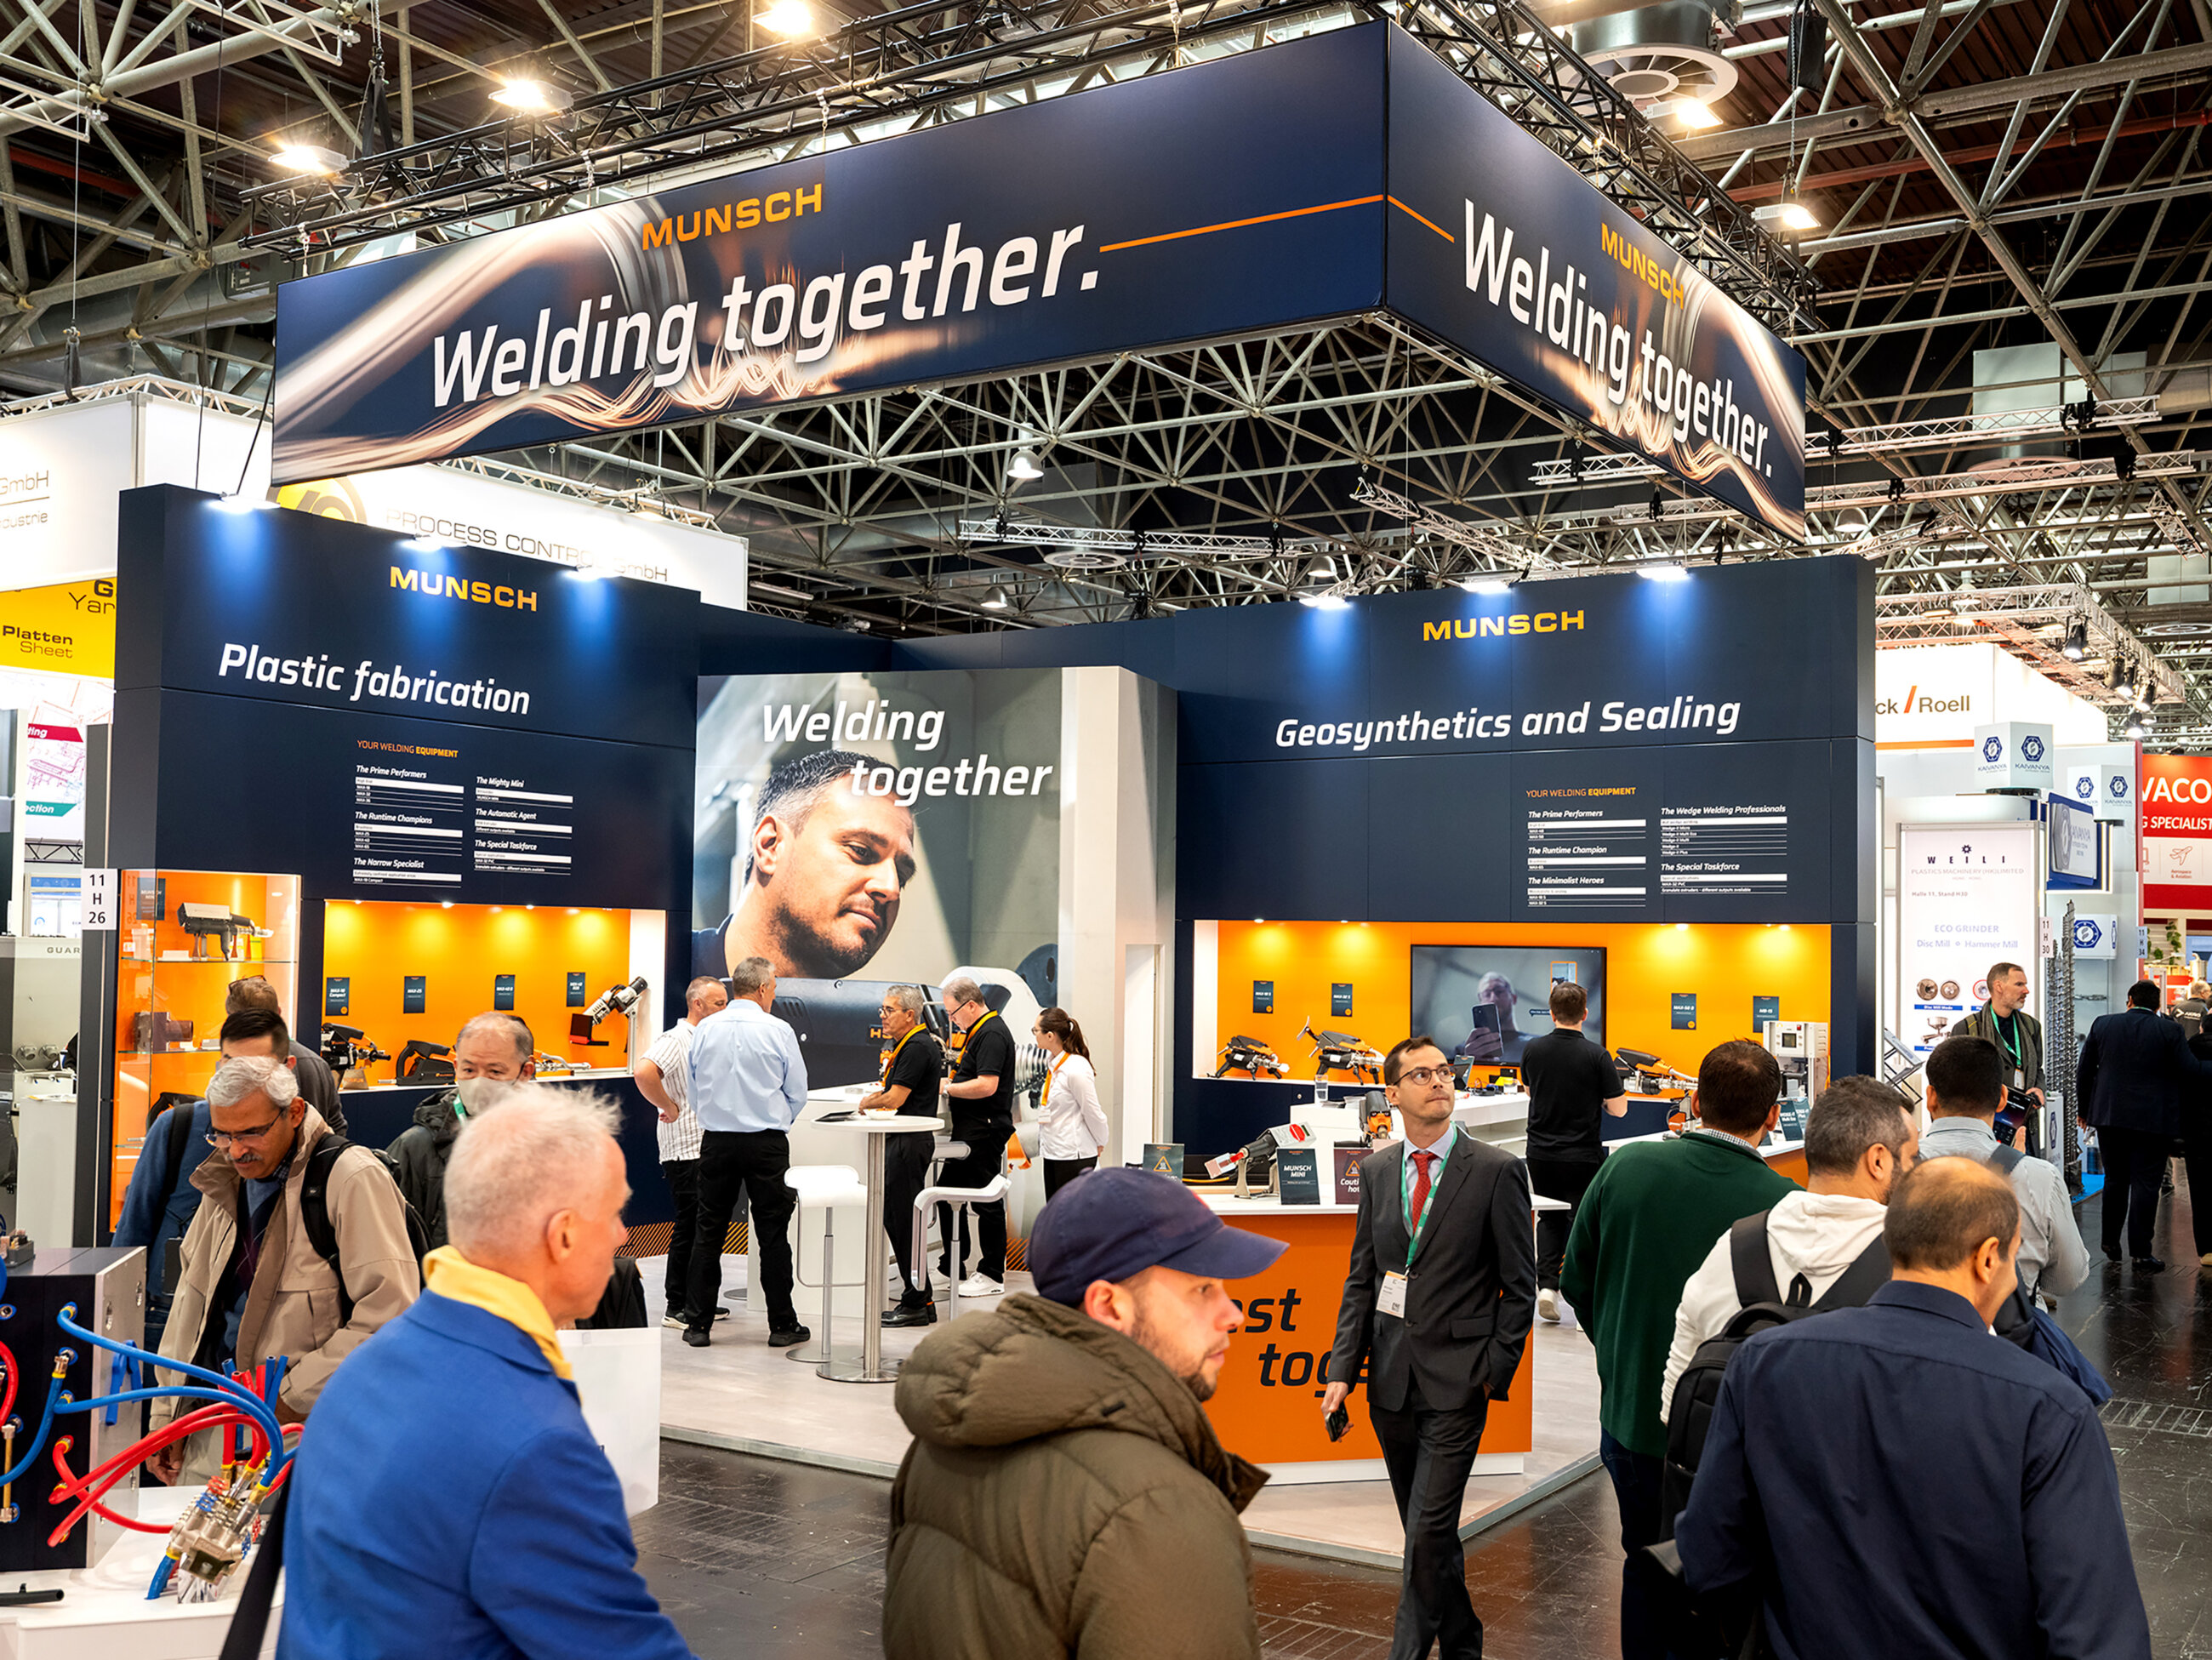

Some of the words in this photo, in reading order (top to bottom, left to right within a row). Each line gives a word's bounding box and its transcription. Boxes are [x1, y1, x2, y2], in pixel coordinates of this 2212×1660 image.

[641, 182, 824, 251] MUNSCH
[1600, 221, 1685, 310] MUNSCH
[433, 294, 698, 408] Welding
[721, 221, 1099, 363] together.
[1464, 197, 1632, 405] Welding
[1640, 328, 1774, 478] together.
[0, 470, 49, 495] GmbH
[0, 511, 48, 529] dustrie
[385, 508, 498, 547] PROCESS
[389, 565, 539, 612] MUNSCH
[1422, 609, 1585, 642] MUNSCH
[3, 625, 73, 646] Platten
[20, 640, 73, 659] Sheet
[219, 642, 345, 693] Plastic
[349, 659, 532, 716] fabrication
[1918, 694, 1970, 714] Roell
[762, 699, 945, 750] Welding
[1275, 706, 1513, 750] Geosynthetics
[1520, 701, 1592, 737] and
[1599, 696, 1742, 735] Sealing
[357, 739, 379, 750] YOUR
[379, 742, 415, 754] WELDING
[415, 746, 459, 758] EQUIPMENT
[356, 764, 369, 773] The
[369, 766, 390, 776] Prime
[391, 767, 427, 779] Performers
[476, 776, 488, 784] The
[488, 777, 510, 788] Mighty
[510, 779, 525, 788] Mini
[849, 754, 1053, 807] together
[1526, 790, 1548, 798] YOUR
[1548, 788, 1587, 797] WELDING
[1588, 787, 1637, 797] EQUIPMENT
[476, 807, 487, 817] The
[487, 809, 518, 819] Automatic
[518, 811, 537, 821] Agent
[1564, 809, 1604, 819] Performers
[1676, 807, 1702, 816] Wedge
[1702, 806, 1734, 816] Welding
[1734, 804, 1787, 814] Professionals
[355, 811, 367, 819] The
[368, 812, 396, 822] Runtime
[396, 813, 433, 825] Champions
[2151, 815, 2212, 830] SPECIALIST
[475, 839, 487, 847] The
[487, 840, 509, 850] Special
[509, 841, 538, 852] Taskforce
[1542, 846, 1571, 854] Runtime
[1572, 845, 1607, 855] Champion
[354, 857, 367, 866] The
[367, 858, 392, 867] Narrow
[392, 859, 425, 869] Specialist
[1661, 863, 1675, 871] The
[1676, 863, 1702, 872] Special
[1703, 862, 1741, 872] Taskforce
[89, 874, 105, 887] 11
[1542, 876, 1579, 884] Minimalist
[1579, 876, 1605, 884] Heroes
[93, 893, 102, 905] H
[88, 911, 106, 924] 26
[1934, 924, 1953, 933] ECO
[1955, 924, 1999, 933] GRINDER
[2042, 921, 2050, 929] 11
[1916, 939, 1934, 948] Disc
[1935, 939, 1951, 948] Mill
[1964, 940, 2001, 949] Hammer
[2002, 940, 2019, 949] Mill
[2042, 944, 2050, 954] 30
[1283, 1164, 1312, 1172] MUNSCH
